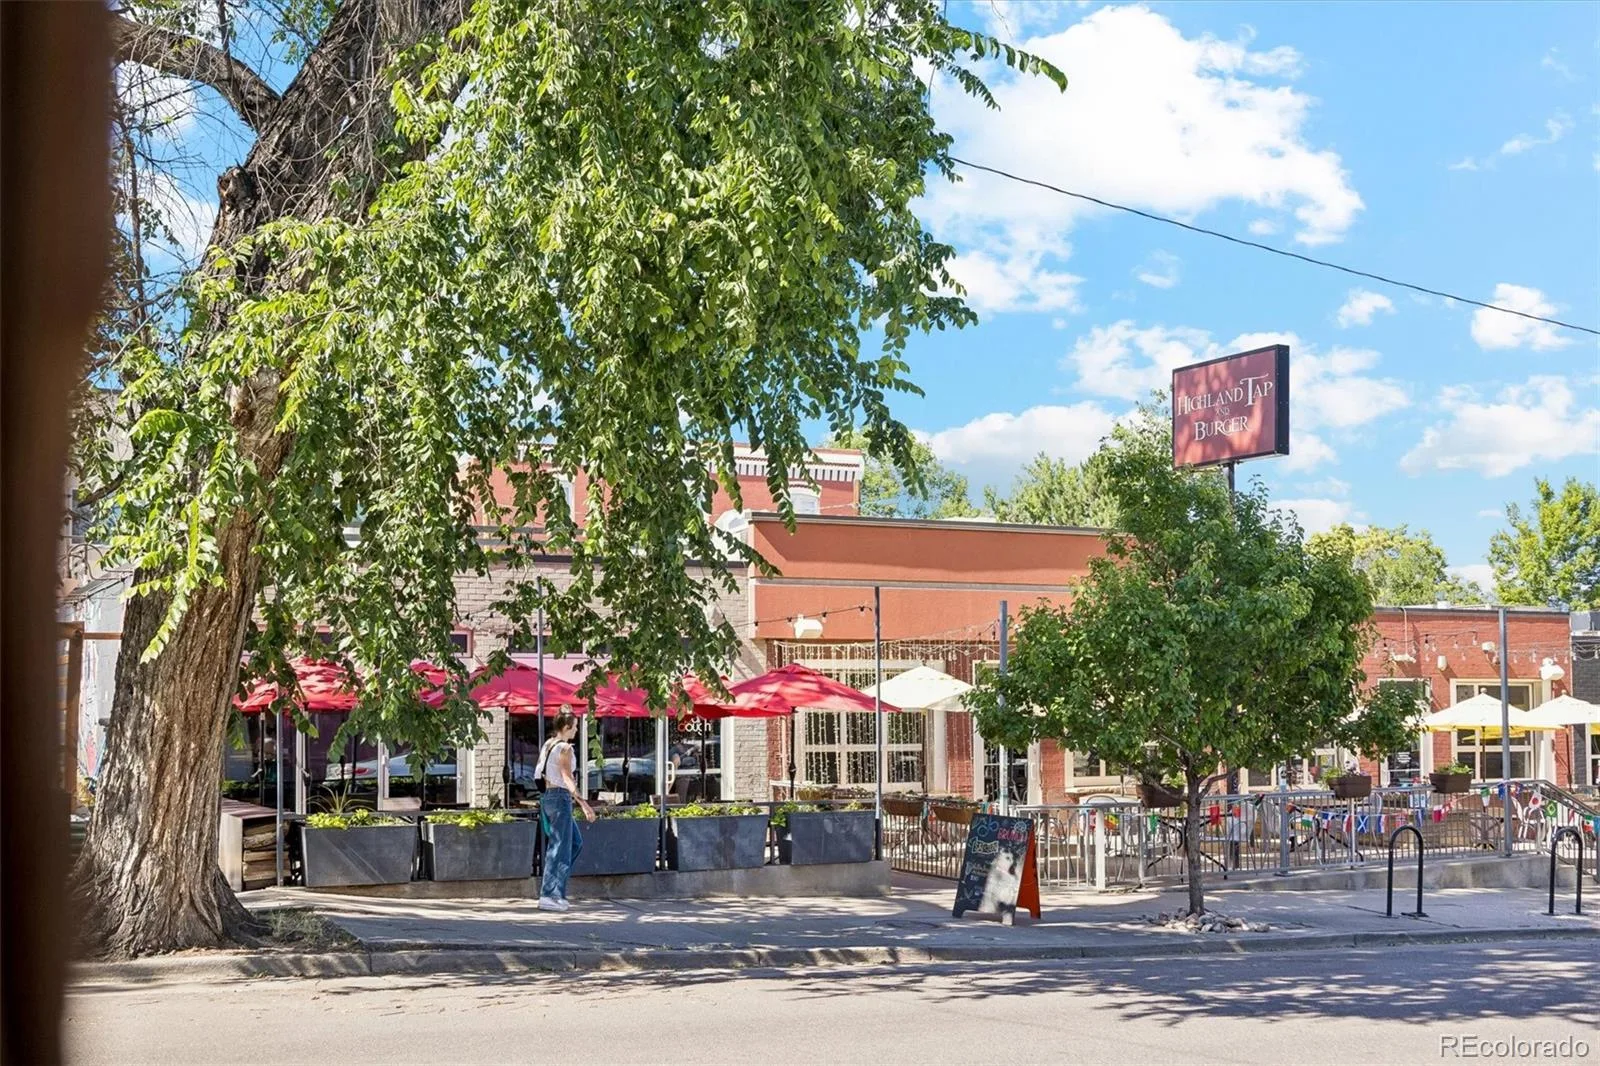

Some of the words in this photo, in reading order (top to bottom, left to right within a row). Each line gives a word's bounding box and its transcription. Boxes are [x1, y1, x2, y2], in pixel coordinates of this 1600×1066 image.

[1177, 387, 1243, 417] HIGHLAND
[1240, 373, 1274, 407] TAP
[1194, 416, 1249, 441] BURGER
